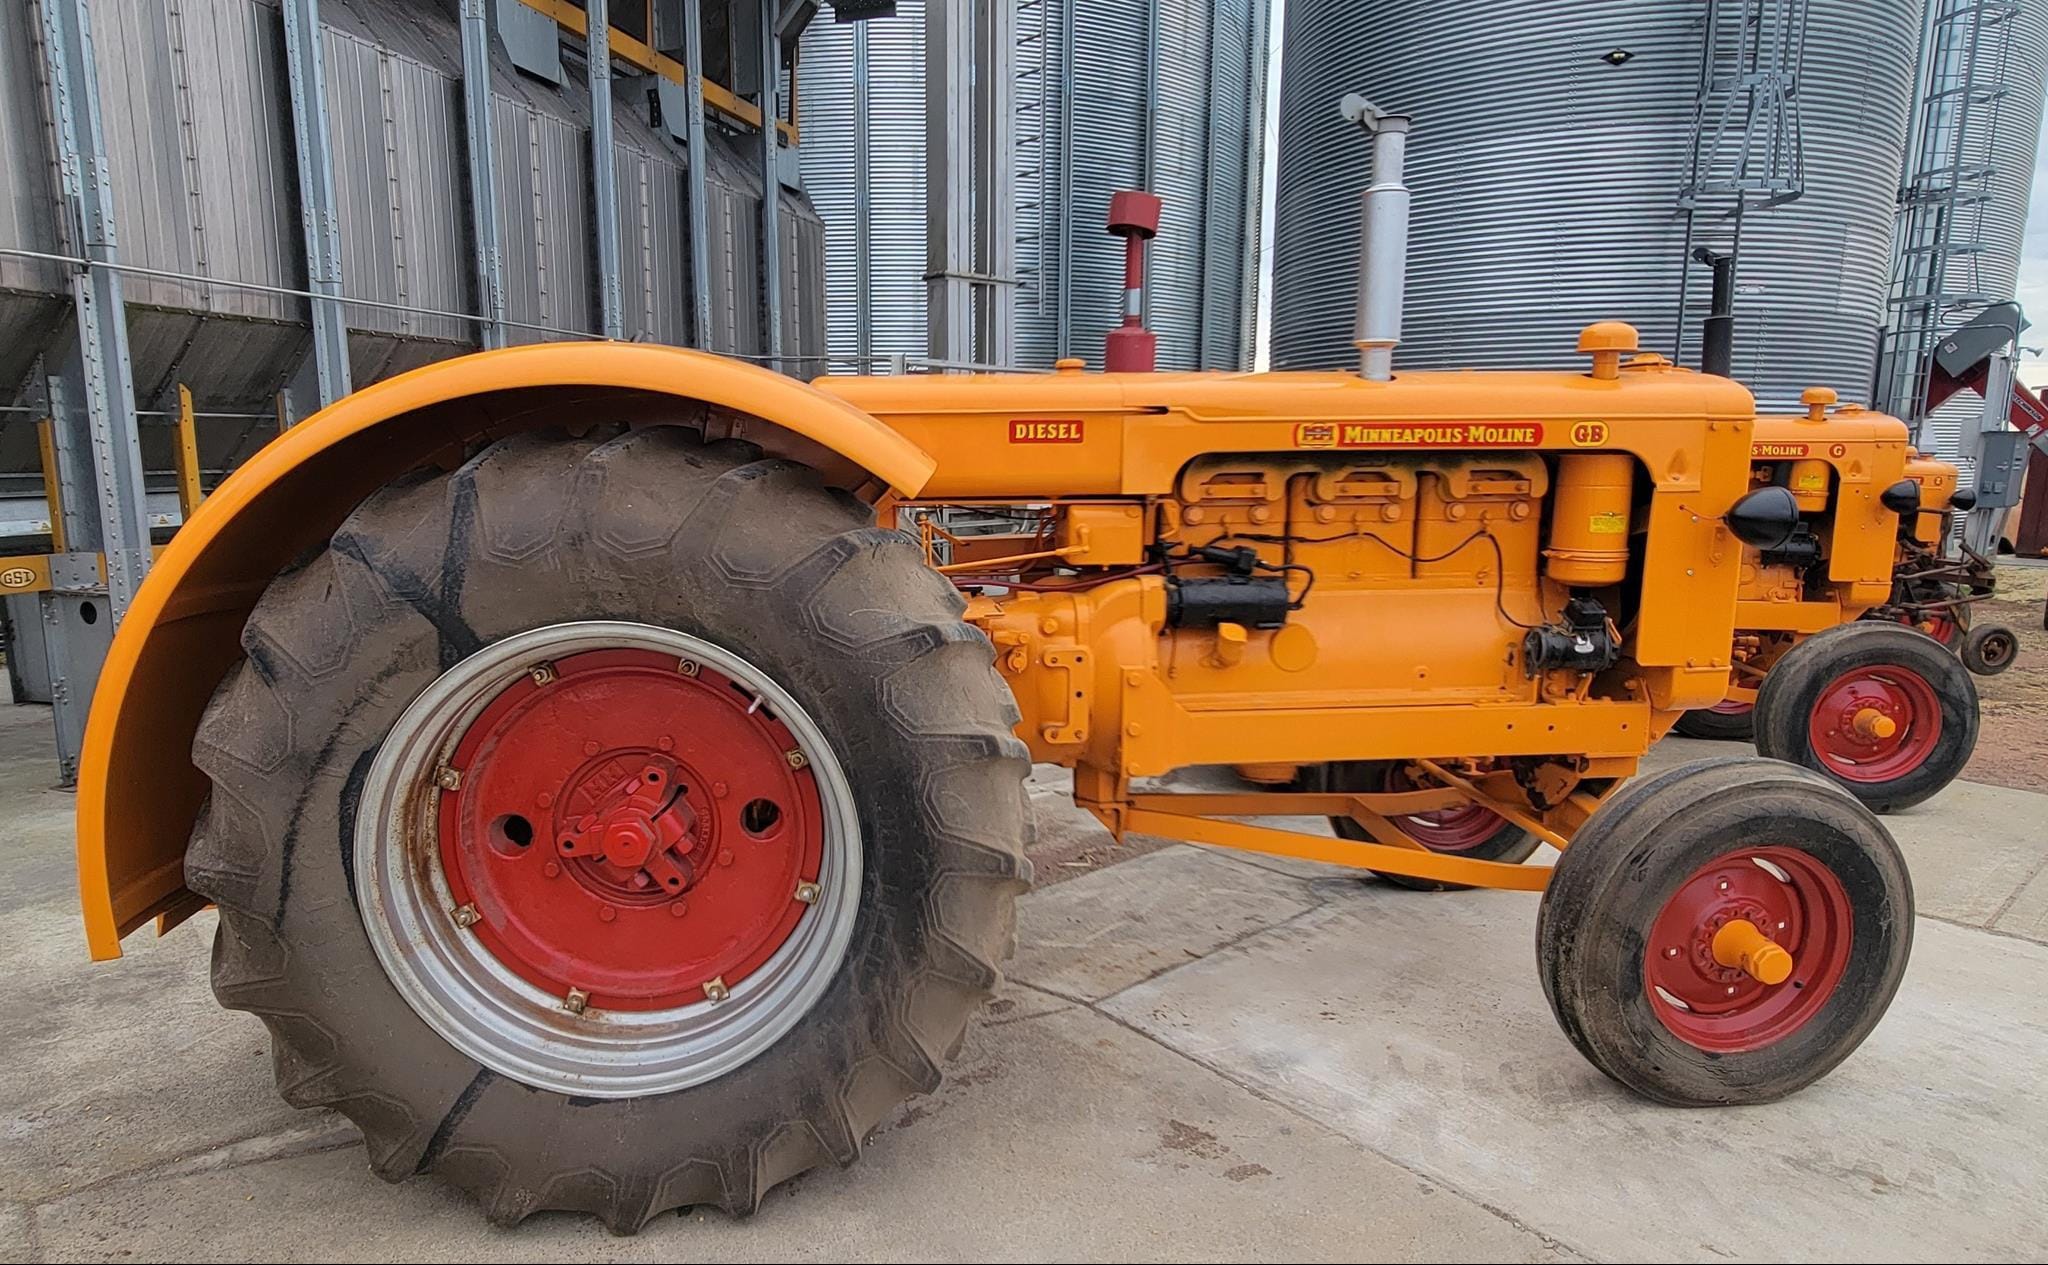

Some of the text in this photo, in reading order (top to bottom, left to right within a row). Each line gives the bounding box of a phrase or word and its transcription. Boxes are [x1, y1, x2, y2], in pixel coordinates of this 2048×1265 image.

[1015, 423, 1081, 439] DIESEL
[1574, 424, 1604, 443] GB
[1833, 446, 1843, 456] G
[4, 572, 31, 584] GSI
